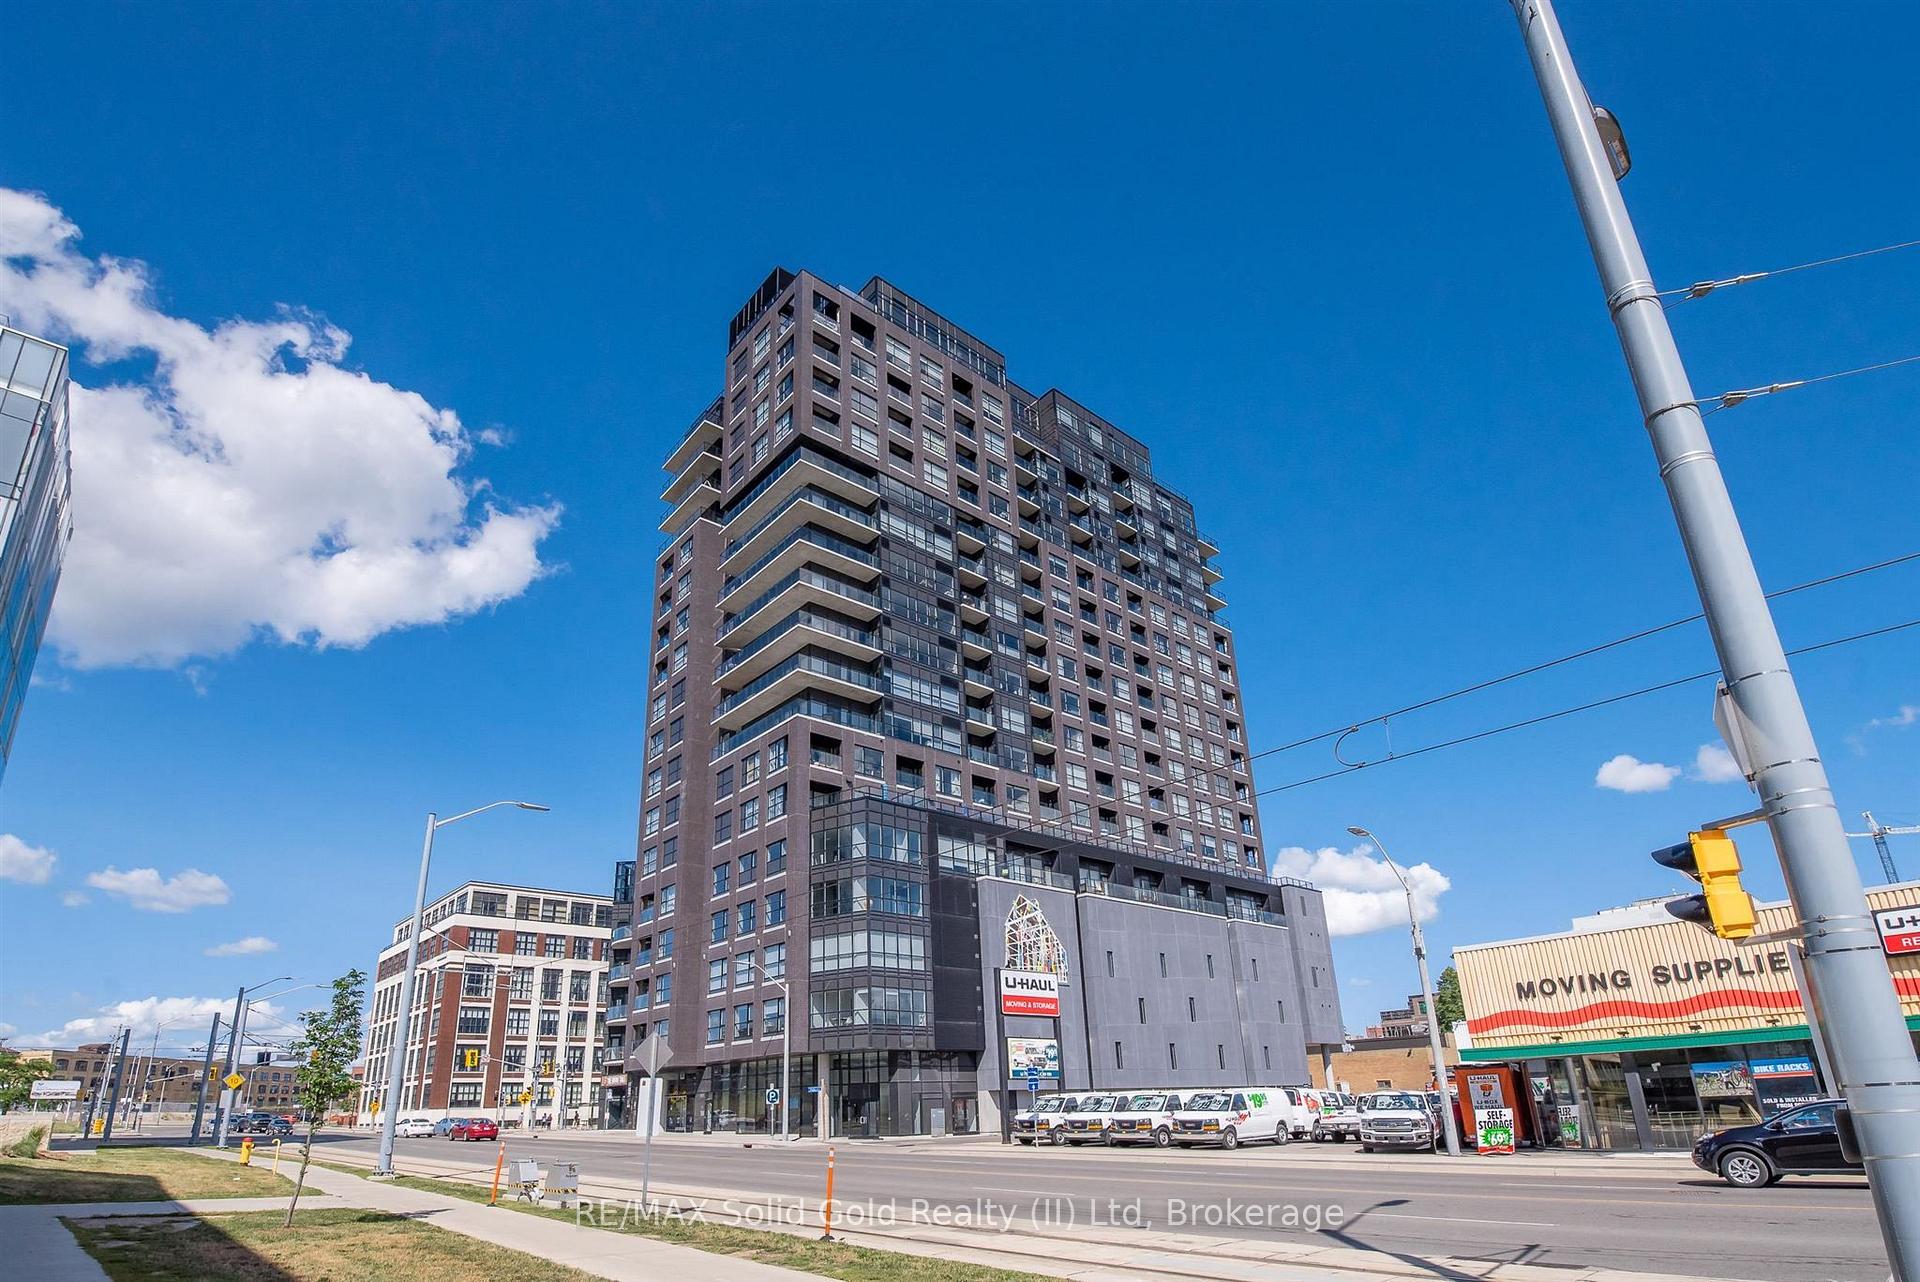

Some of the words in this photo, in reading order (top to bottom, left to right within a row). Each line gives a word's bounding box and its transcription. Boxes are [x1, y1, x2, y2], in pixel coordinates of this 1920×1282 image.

[1005, 976, 1055, 991] U-HAUL
[1516, 969, 1632, 1000] MOVING
[1005, 1000, 1027, 1008] MOVING
[1033, 1001, 1057, 1010] STORAGE
[1753, 1065, 1776, 1073] BIKE
[1777, 1063, 1810, 1072] RACKS
[1487, 1110, 1507, 1120] SELF-
[1478, 1119, 1513, 1130] STORAGE
